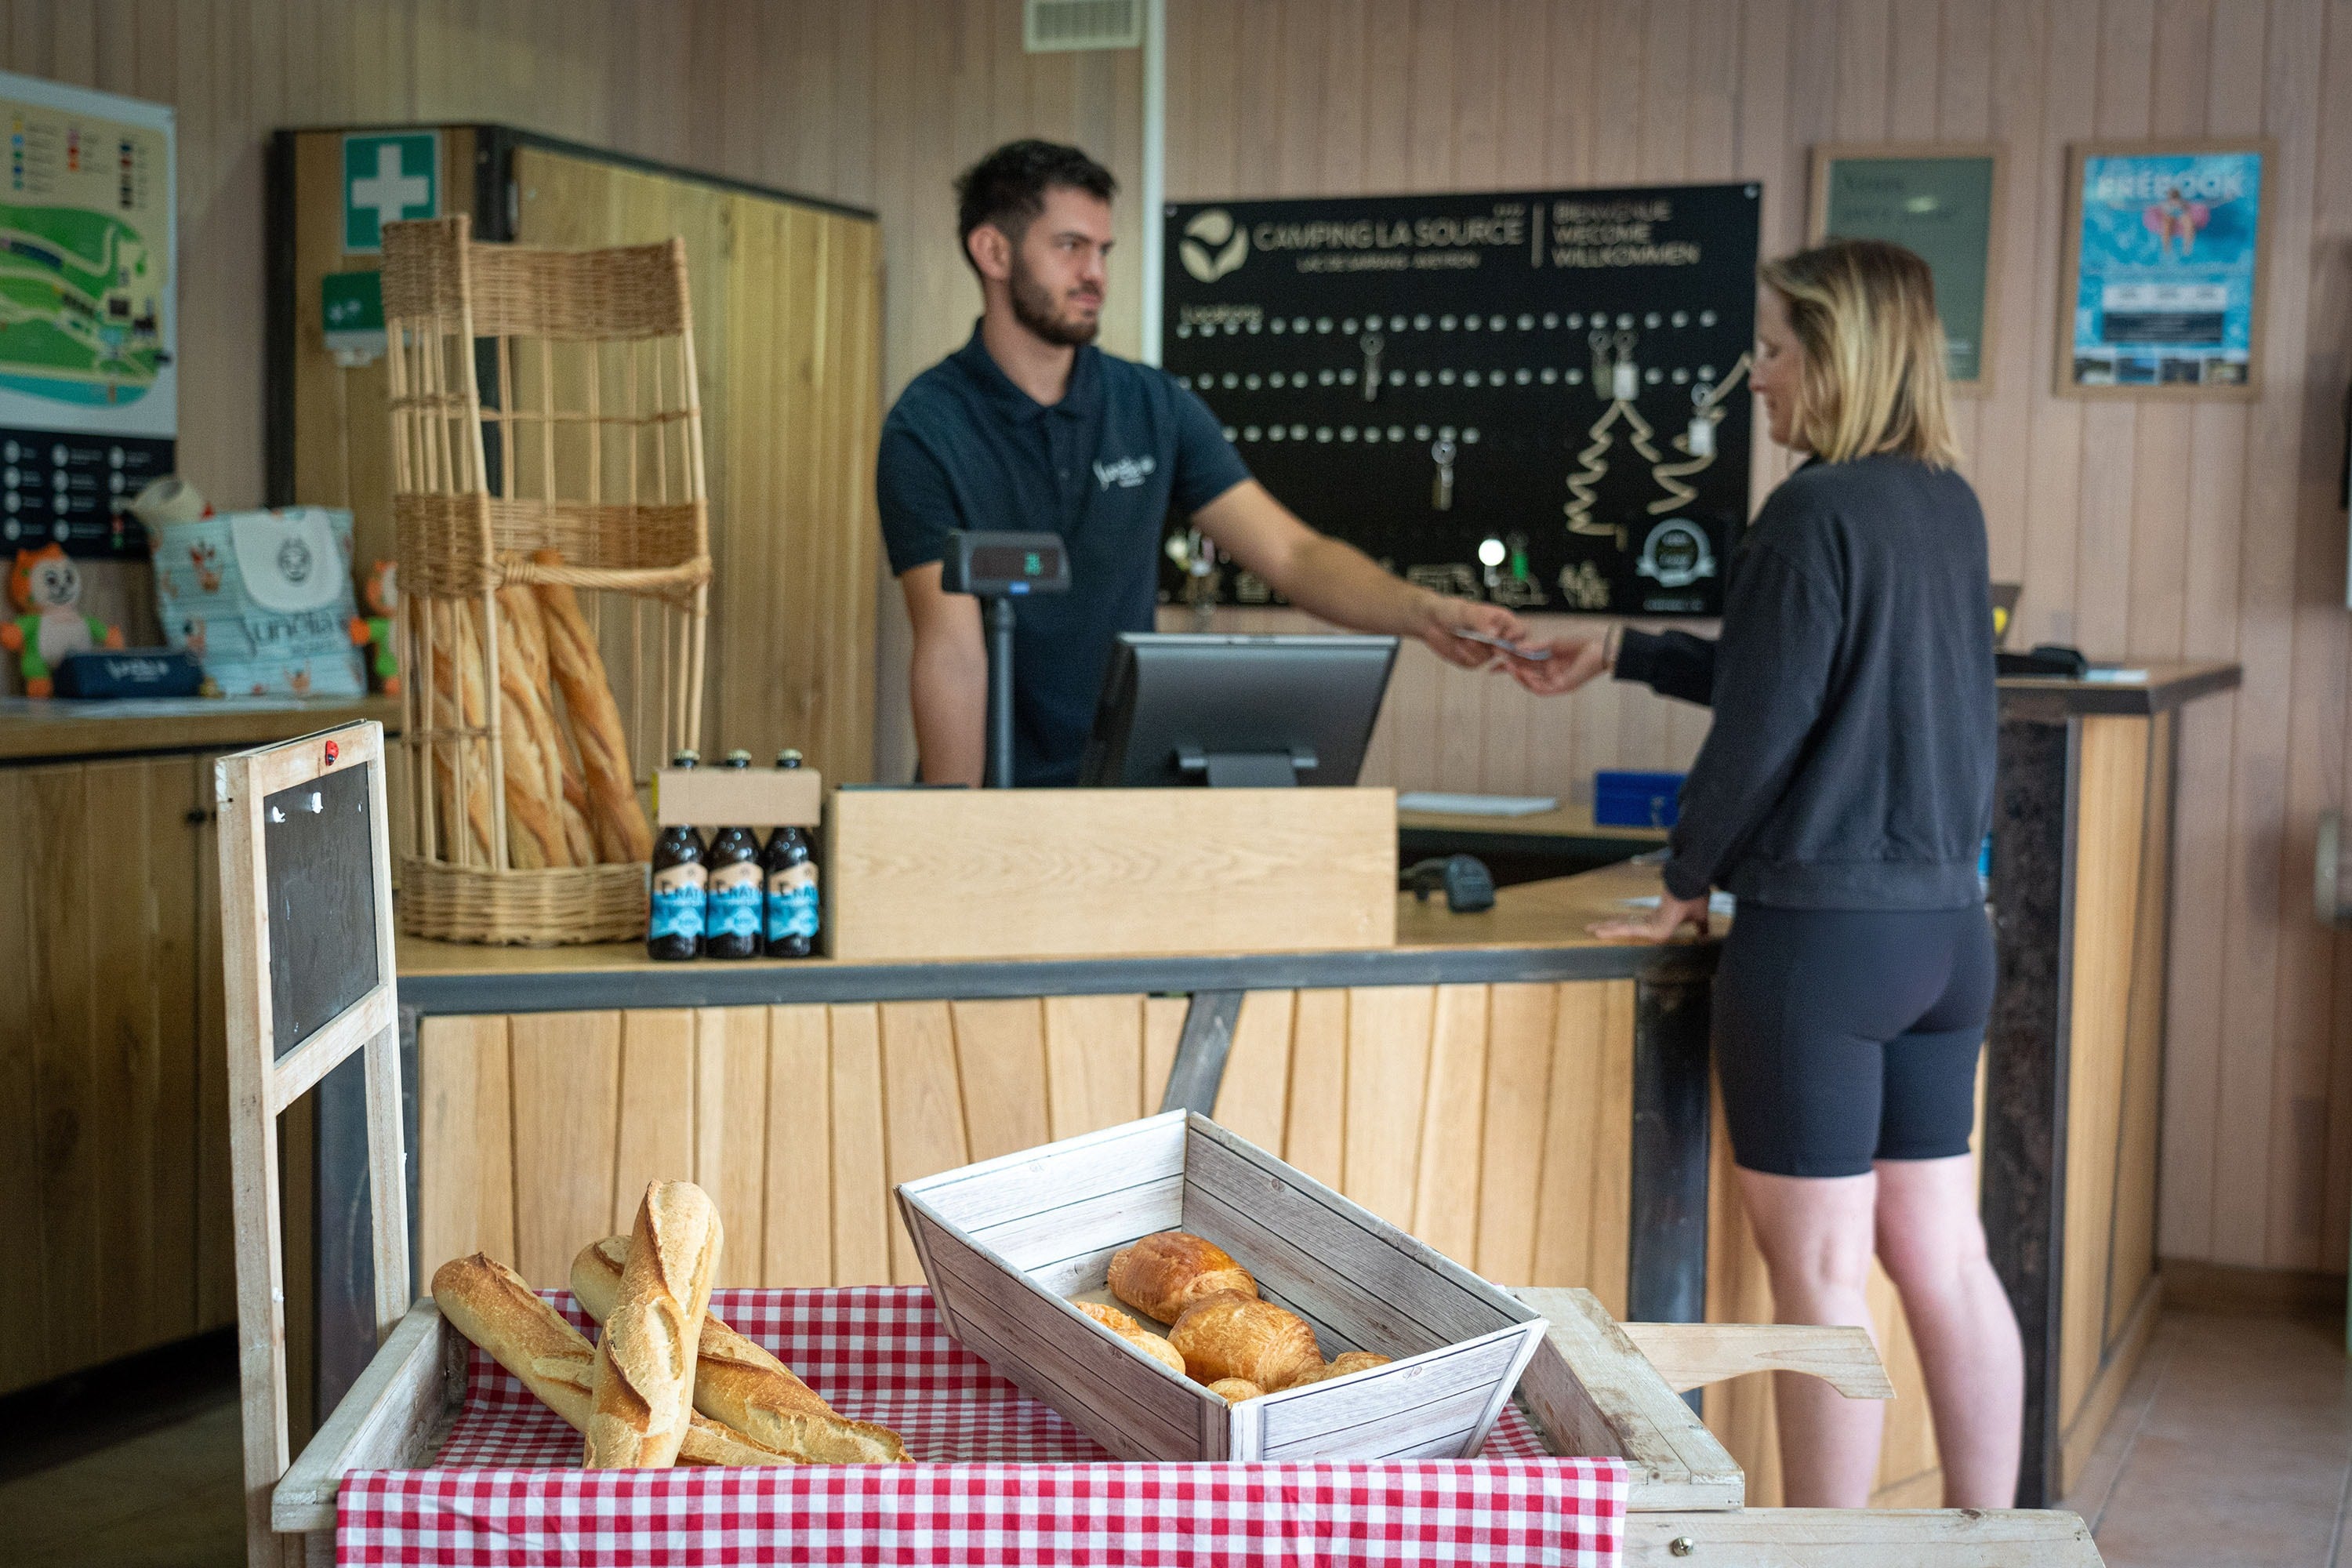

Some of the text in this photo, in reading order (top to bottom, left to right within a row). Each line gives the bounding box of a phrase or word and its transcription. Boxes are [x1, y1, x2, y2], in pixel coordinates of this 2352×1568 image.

[1254, 216, 1525, 252] CAMPING LA SOURCE
[1552, 241, 1700, 268] WILLKOMMEN
